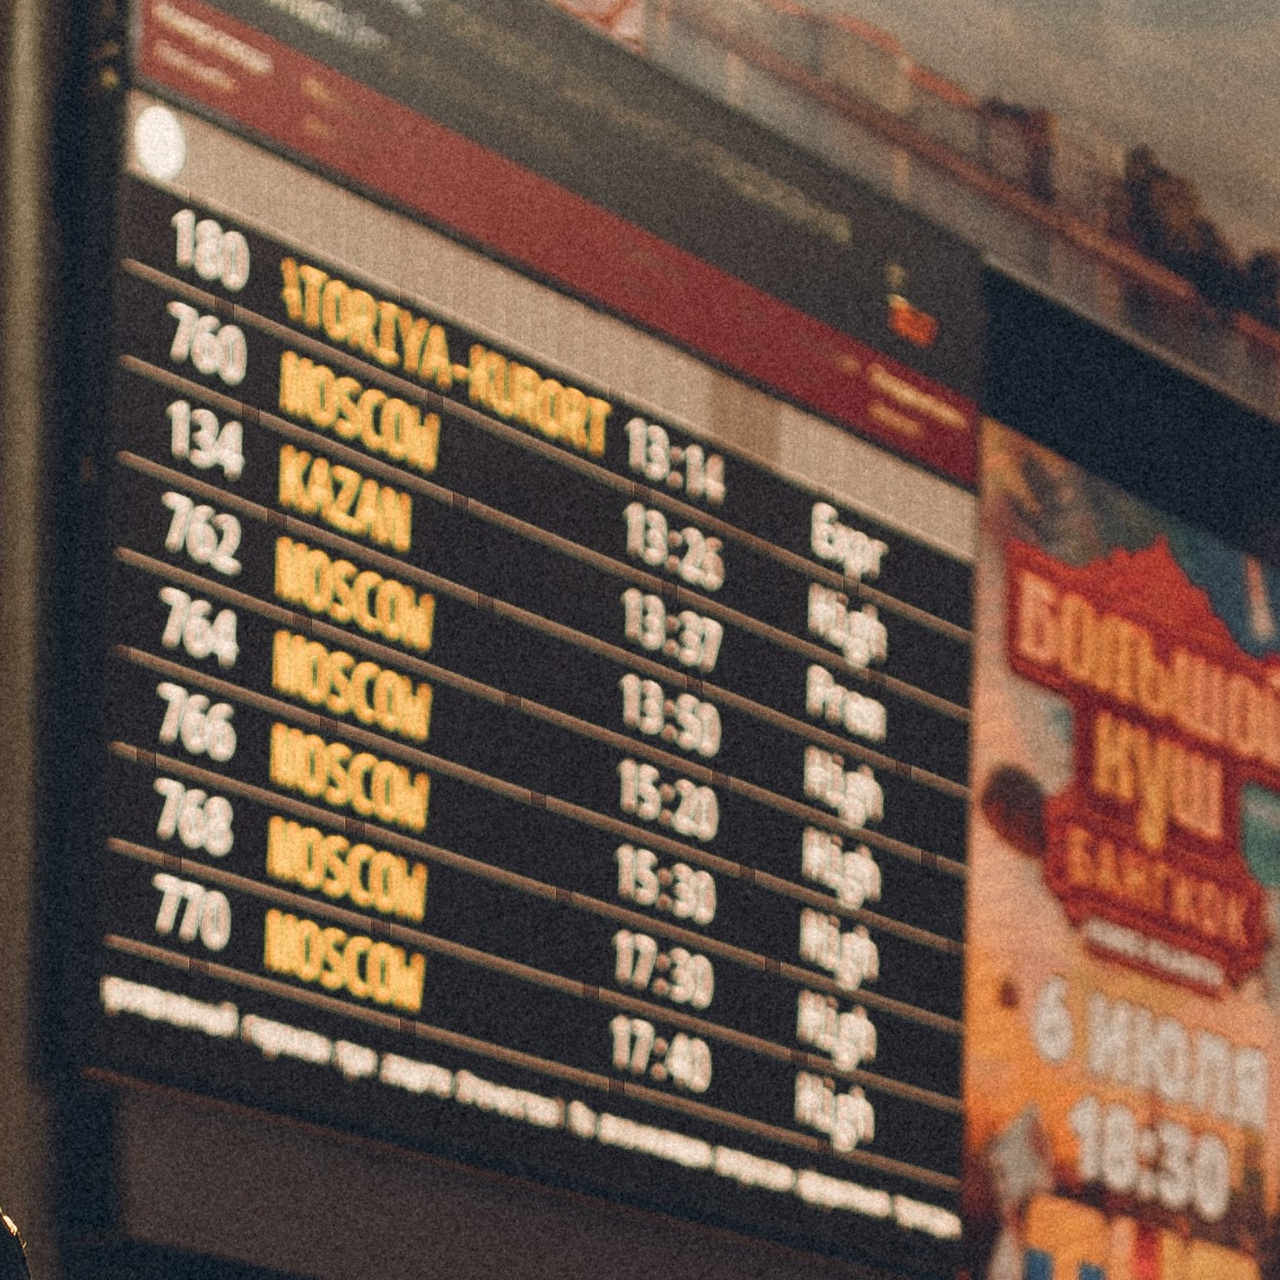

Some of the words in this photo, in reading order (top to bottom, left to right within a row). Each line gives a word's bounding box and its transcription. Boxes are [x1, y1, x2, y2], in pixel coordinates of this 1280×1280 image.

[168, 301, 246, 384] 760
[279, 351, 440, 471] MOSCOW
[625, 503, 724, 590] 13:25
[171, 209, 249, 291] 180
[626, 418, 725, 501] 13:14
[163, 491, 241, 575] 762
[275, 536, 435, 650] MOSCOW
[621, 673, 721, 757] 13:50
[168, 400, 244, 477] 134
[279, 445, 411, 552] KAZAN
[623, 588, 723, 669] 13:37
[158, 682, 236, 761] 766
[270, 723, 430, 831] MOSCOW
[617, 844, 716, 924] 15:30
[160, 587, 238, 665] 764
[272, 630, 432, 741] MOSCOW
[619, 759, 719, 840] 15:20
[1095, 712, 1222, 850] КУШ
[154, 873, 230, 950] 770
[265, 909, 425, 1011] MOSCOW
[611, 1015, 712, 1092] 17:40
[155, 778, 233, 856] 768
[267, 816, 427, 921] MOSCOW
[614, 930, 714, 1008] 17:30
[1032, 974, 1074, 1065] 6
[1086, 991, 1268, 1131] ИЮЛЯ
[1067, 1095, 1231, 1222] 18:30
